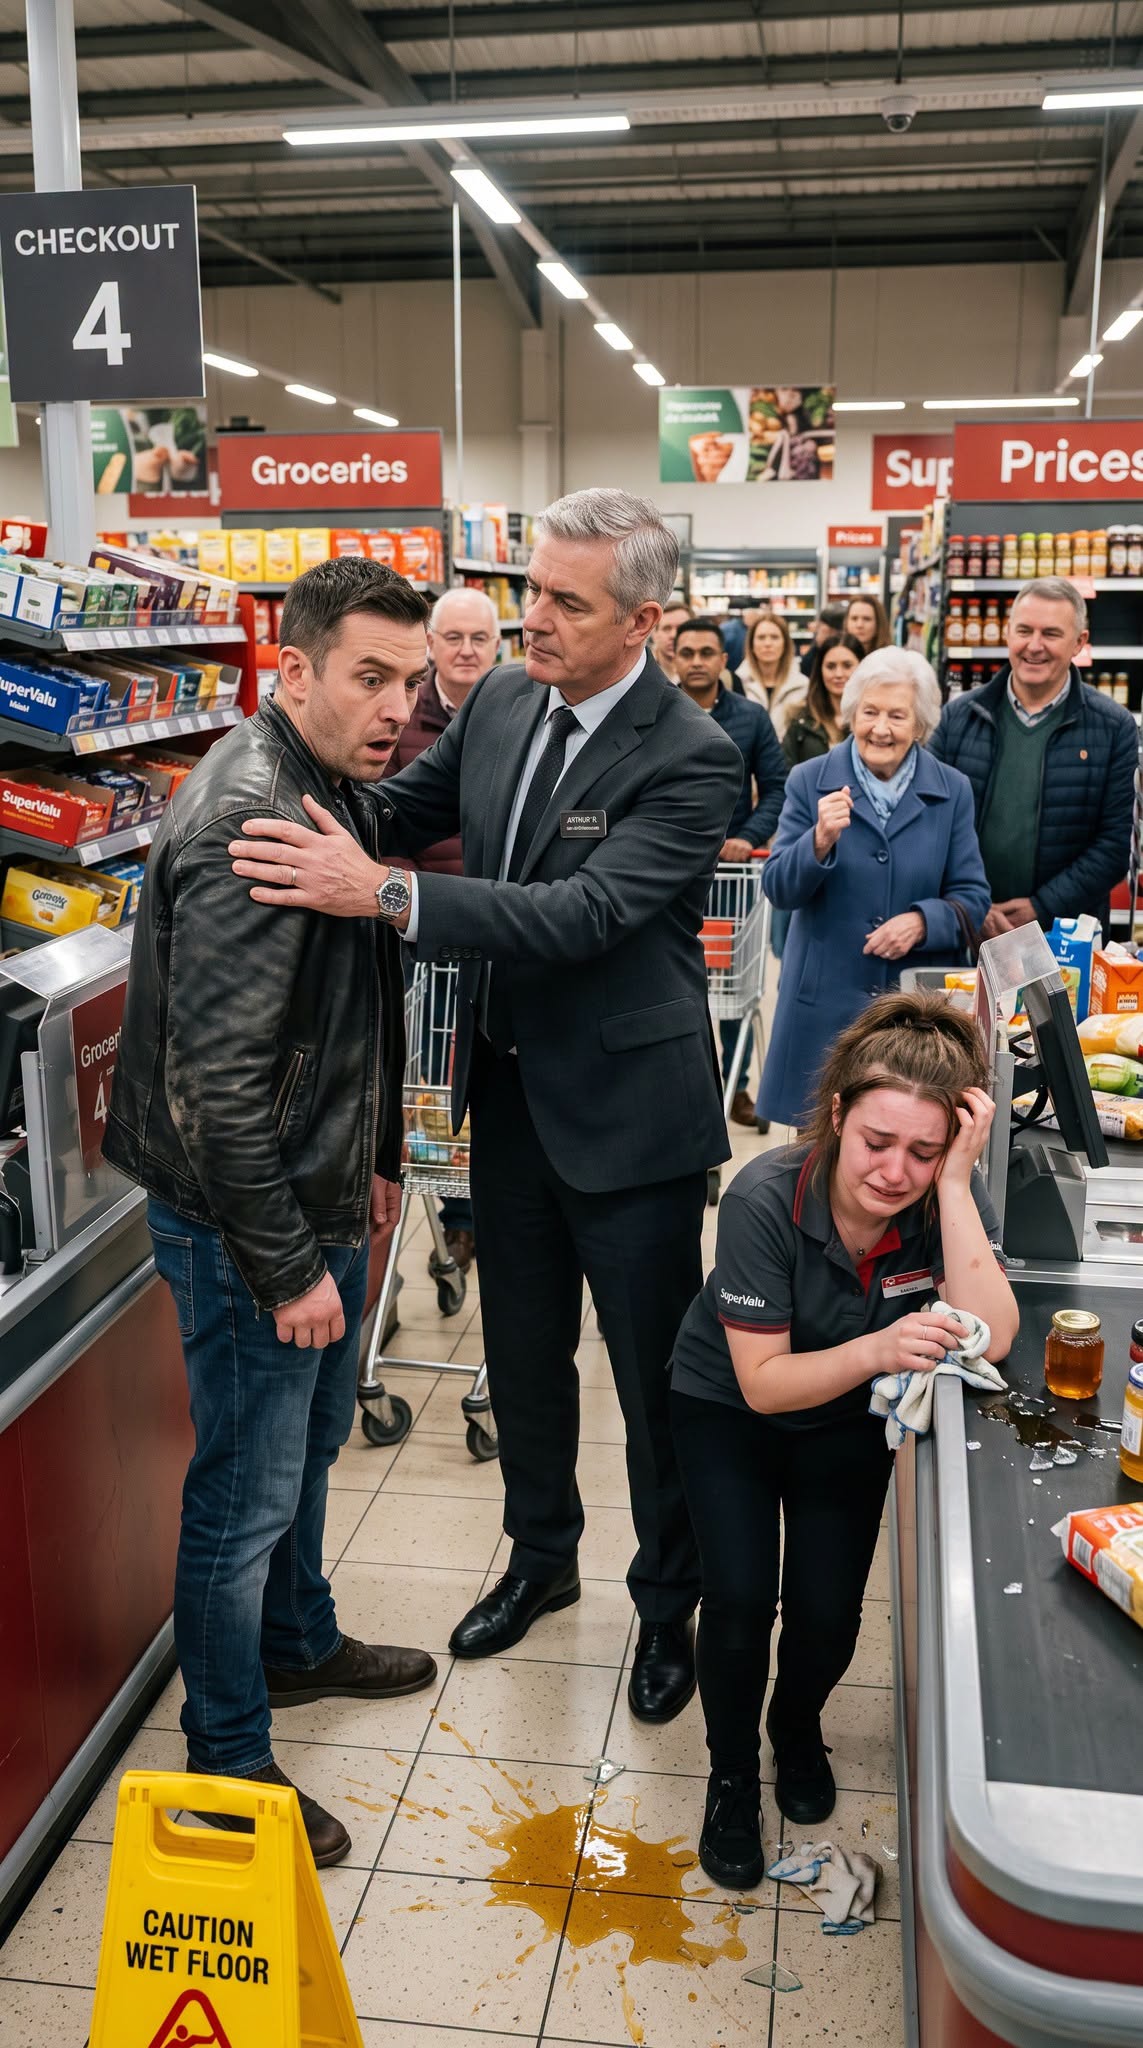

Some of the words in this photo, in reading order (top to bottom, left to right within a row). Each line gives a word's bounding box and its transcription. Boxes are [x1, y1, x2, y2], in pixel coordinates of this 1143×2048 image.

[14, 223, 180, 256] CHECKOUT
[72, 281, 132, 366] 4
[251, 452, 408, 486] Groceries
[0, 676, 57, 708] uperValu
[2, 790, 61, 818] SuperValu
[94, 1081, 107, 1124] 4
[720, 1288, 765, 1308] SuperValu
[143, 1909, 254, 1948] CAUTION
[126, 1941, 179, 1973] WET
[187, 1949, 269, 1985] FLOOR
